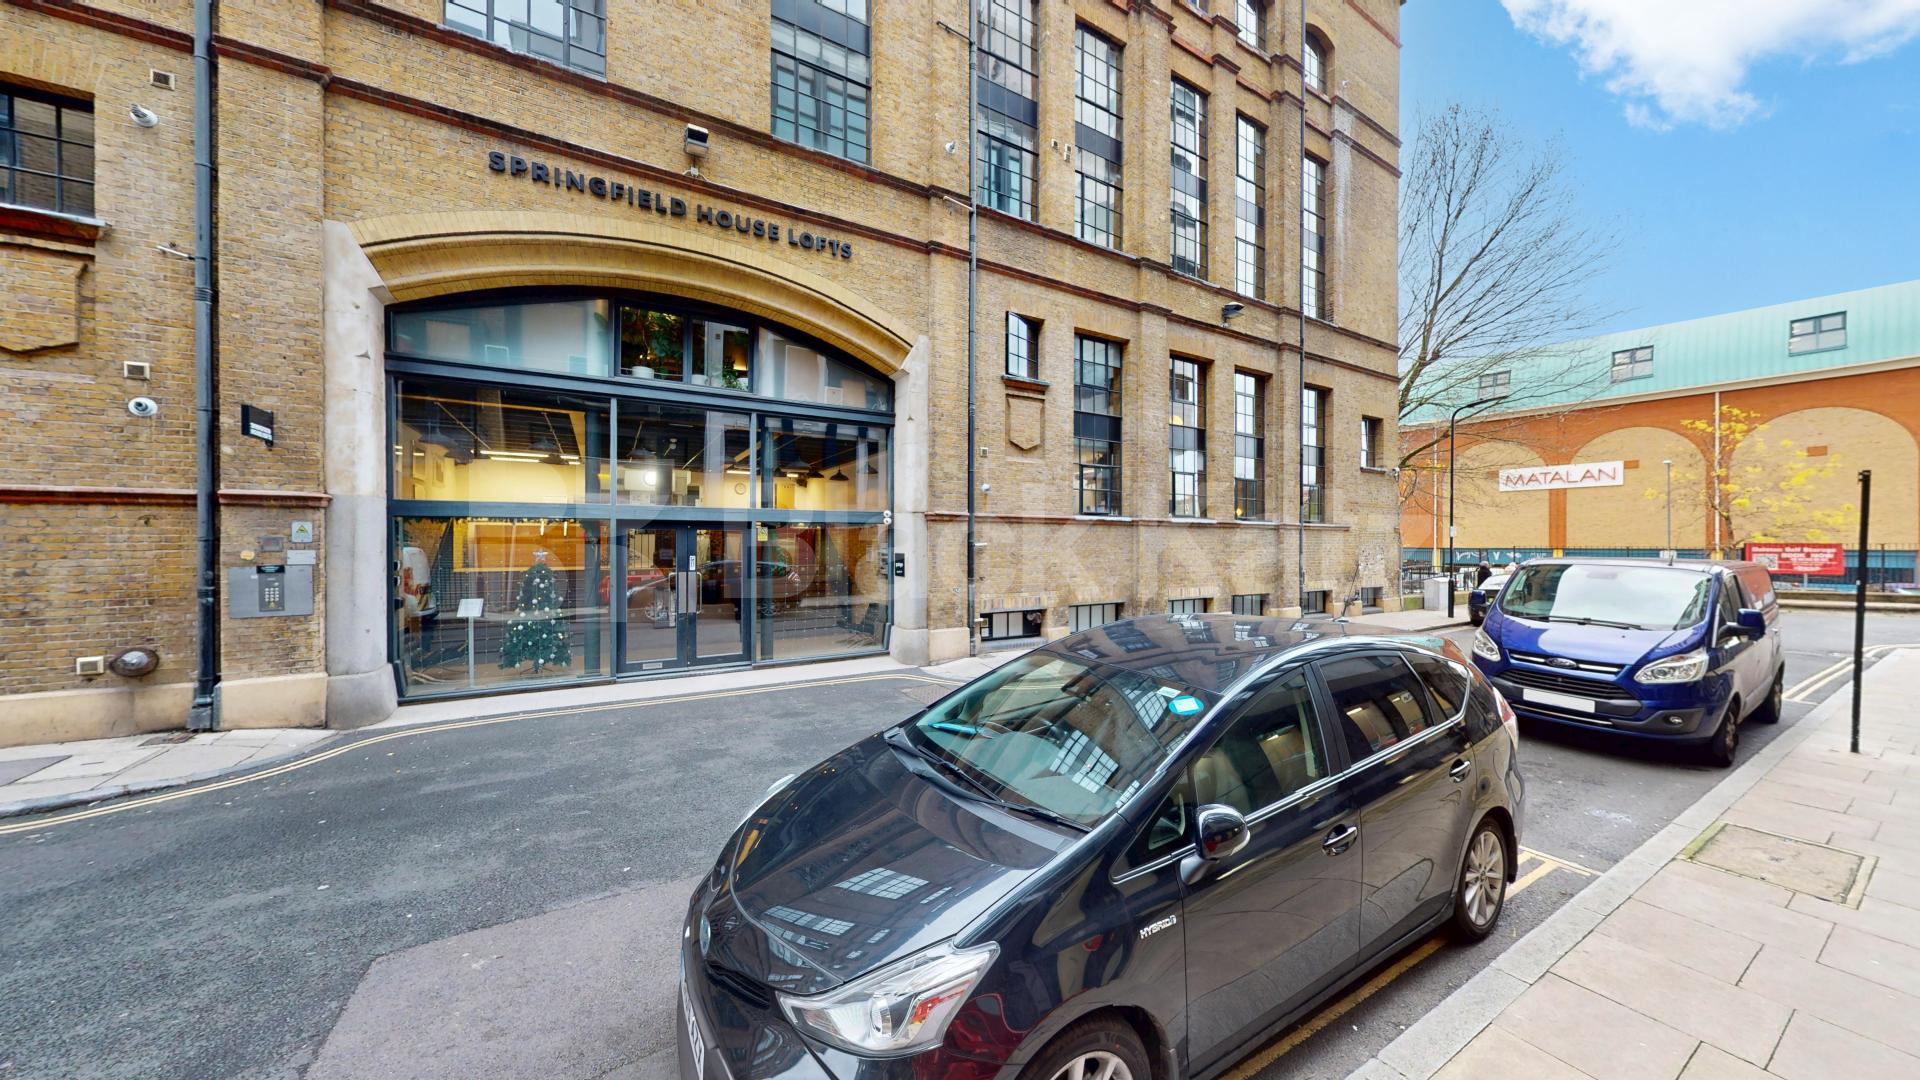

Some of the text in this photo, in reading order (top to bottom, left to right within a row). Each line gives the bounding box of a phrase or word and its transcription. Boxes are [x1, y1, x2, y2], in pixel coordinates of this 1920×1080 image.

[488, 150, 853, 259] SPRINGFIELD HOUSE LOFTS
[1504, 467, 1617, 487] MATALAN
[1139, 915, 1175, 939] HYBRID
